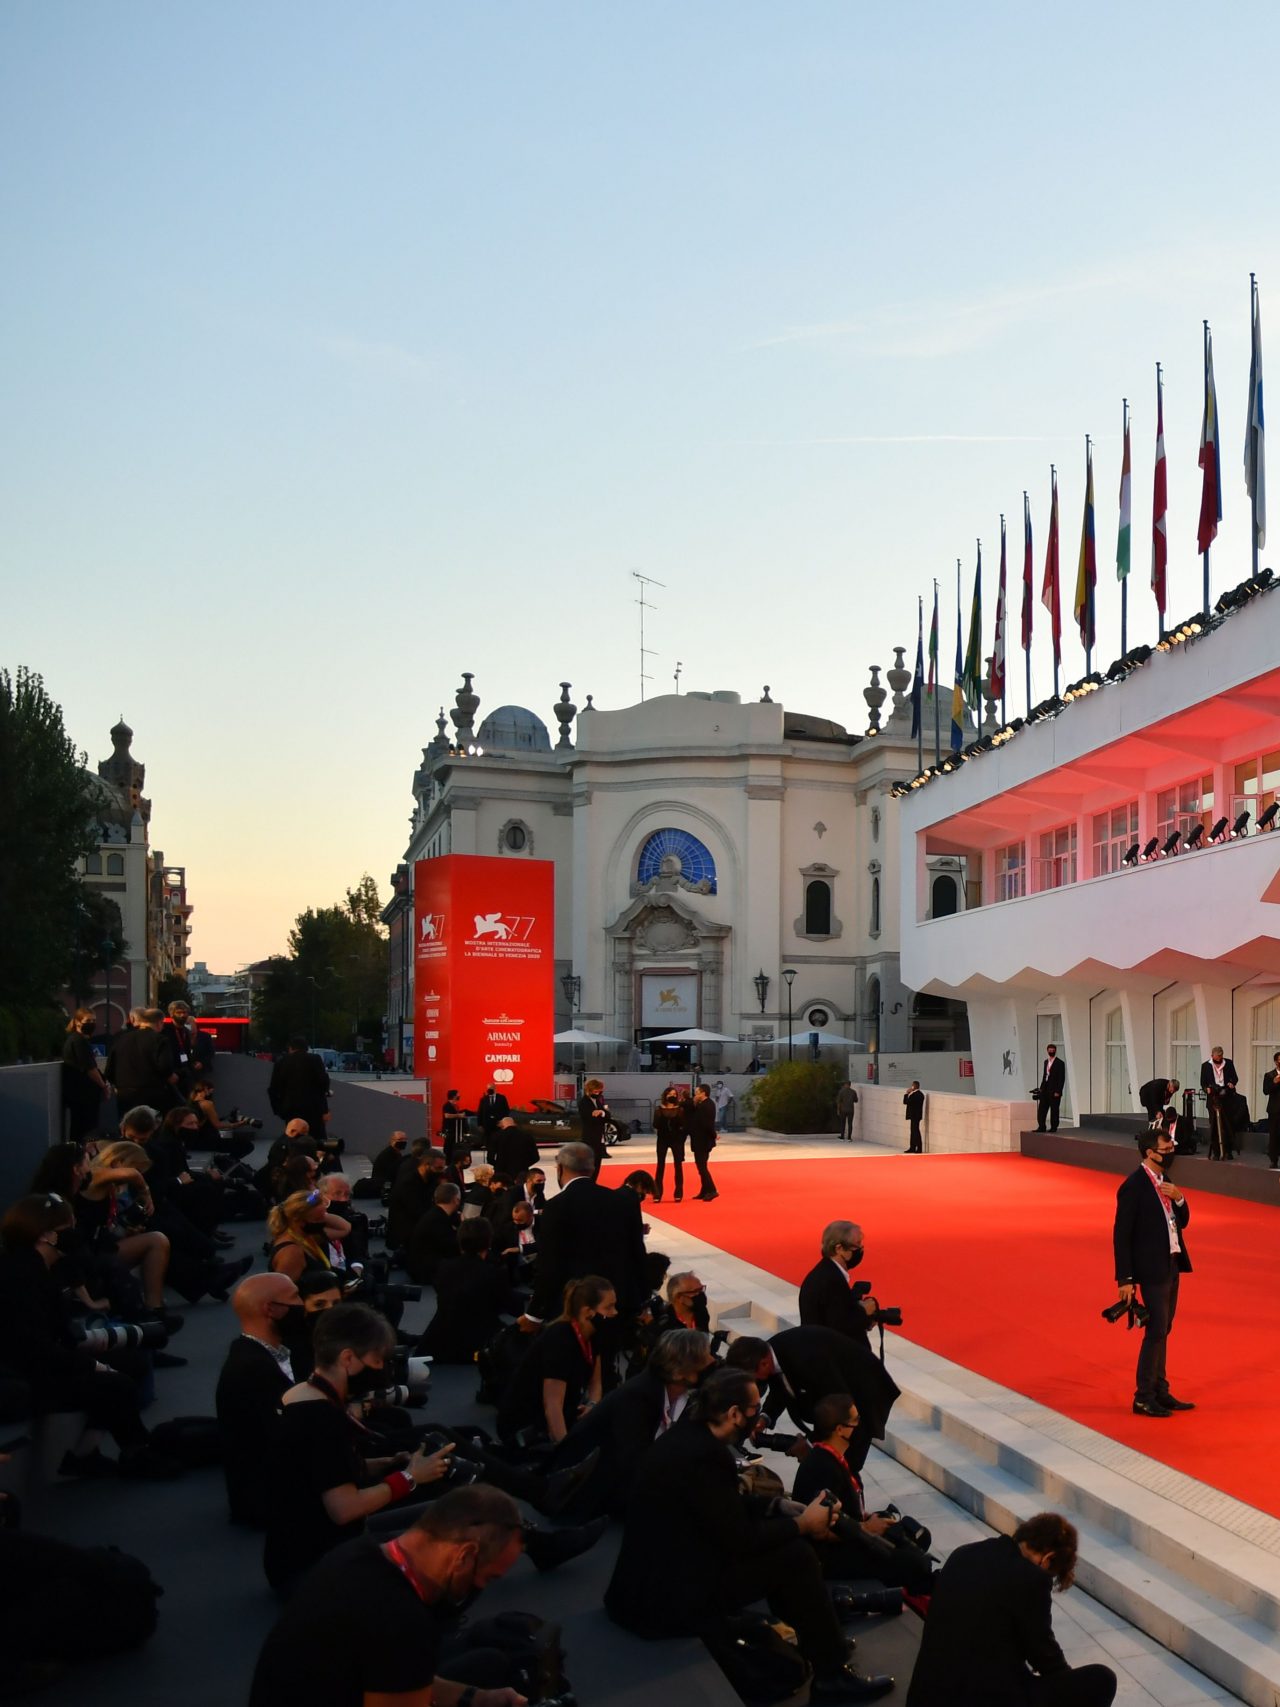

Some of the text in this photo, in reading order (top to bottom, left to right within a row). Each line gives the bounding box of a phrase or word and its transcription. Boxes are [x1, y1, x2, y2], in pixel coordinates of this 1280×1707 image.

[505, 915, 536, 941] 77
[487, 1032, 521, 1041] ARMANI
[485, 1054, 521, 1063] CAMPARI
